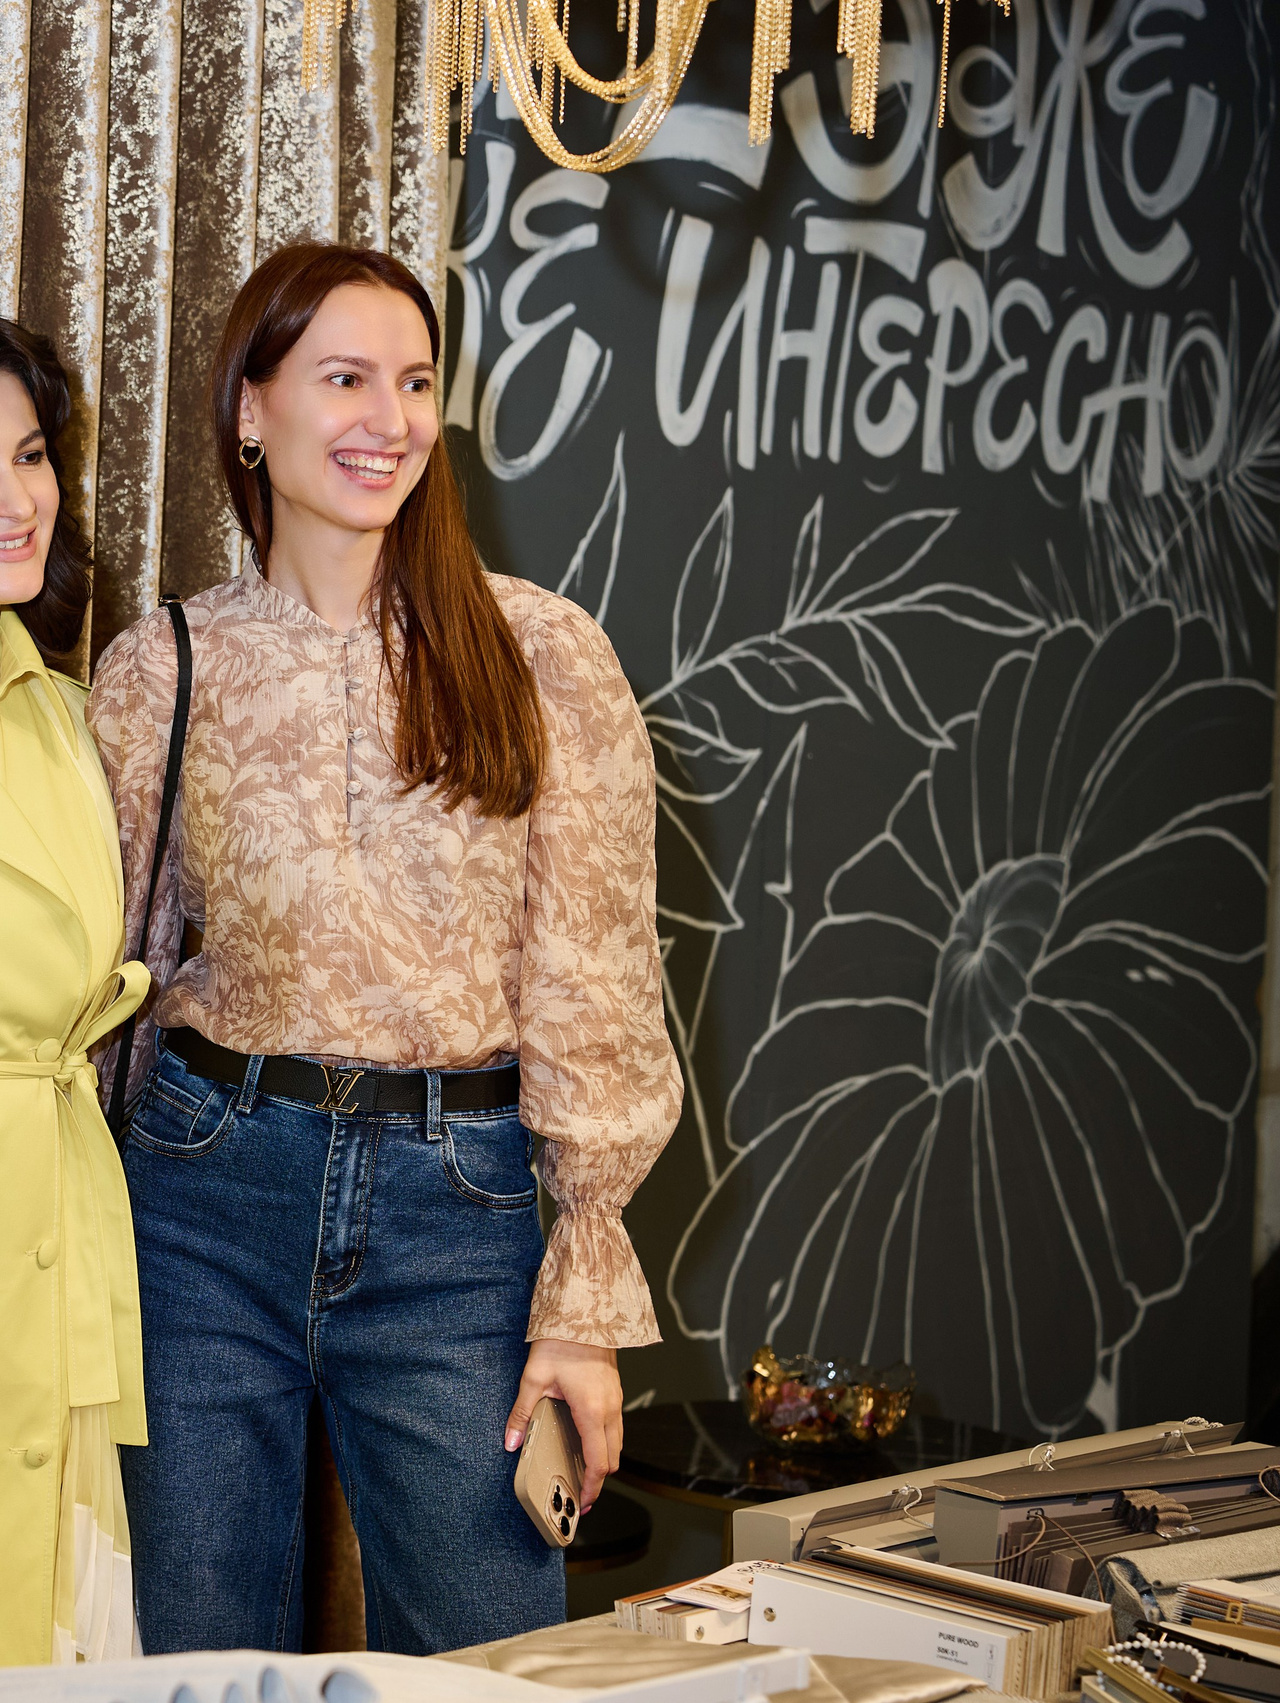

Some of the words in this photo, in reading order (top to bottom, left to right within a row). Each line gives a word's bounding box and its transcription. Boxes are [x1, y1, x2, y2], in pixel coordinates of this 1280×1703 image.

[655, 214, 1230, 504] ИНТЕРЕСНО
[938, 1632, 956, 1642] PURE
[957, 1637, 979, 1648] WOOD
